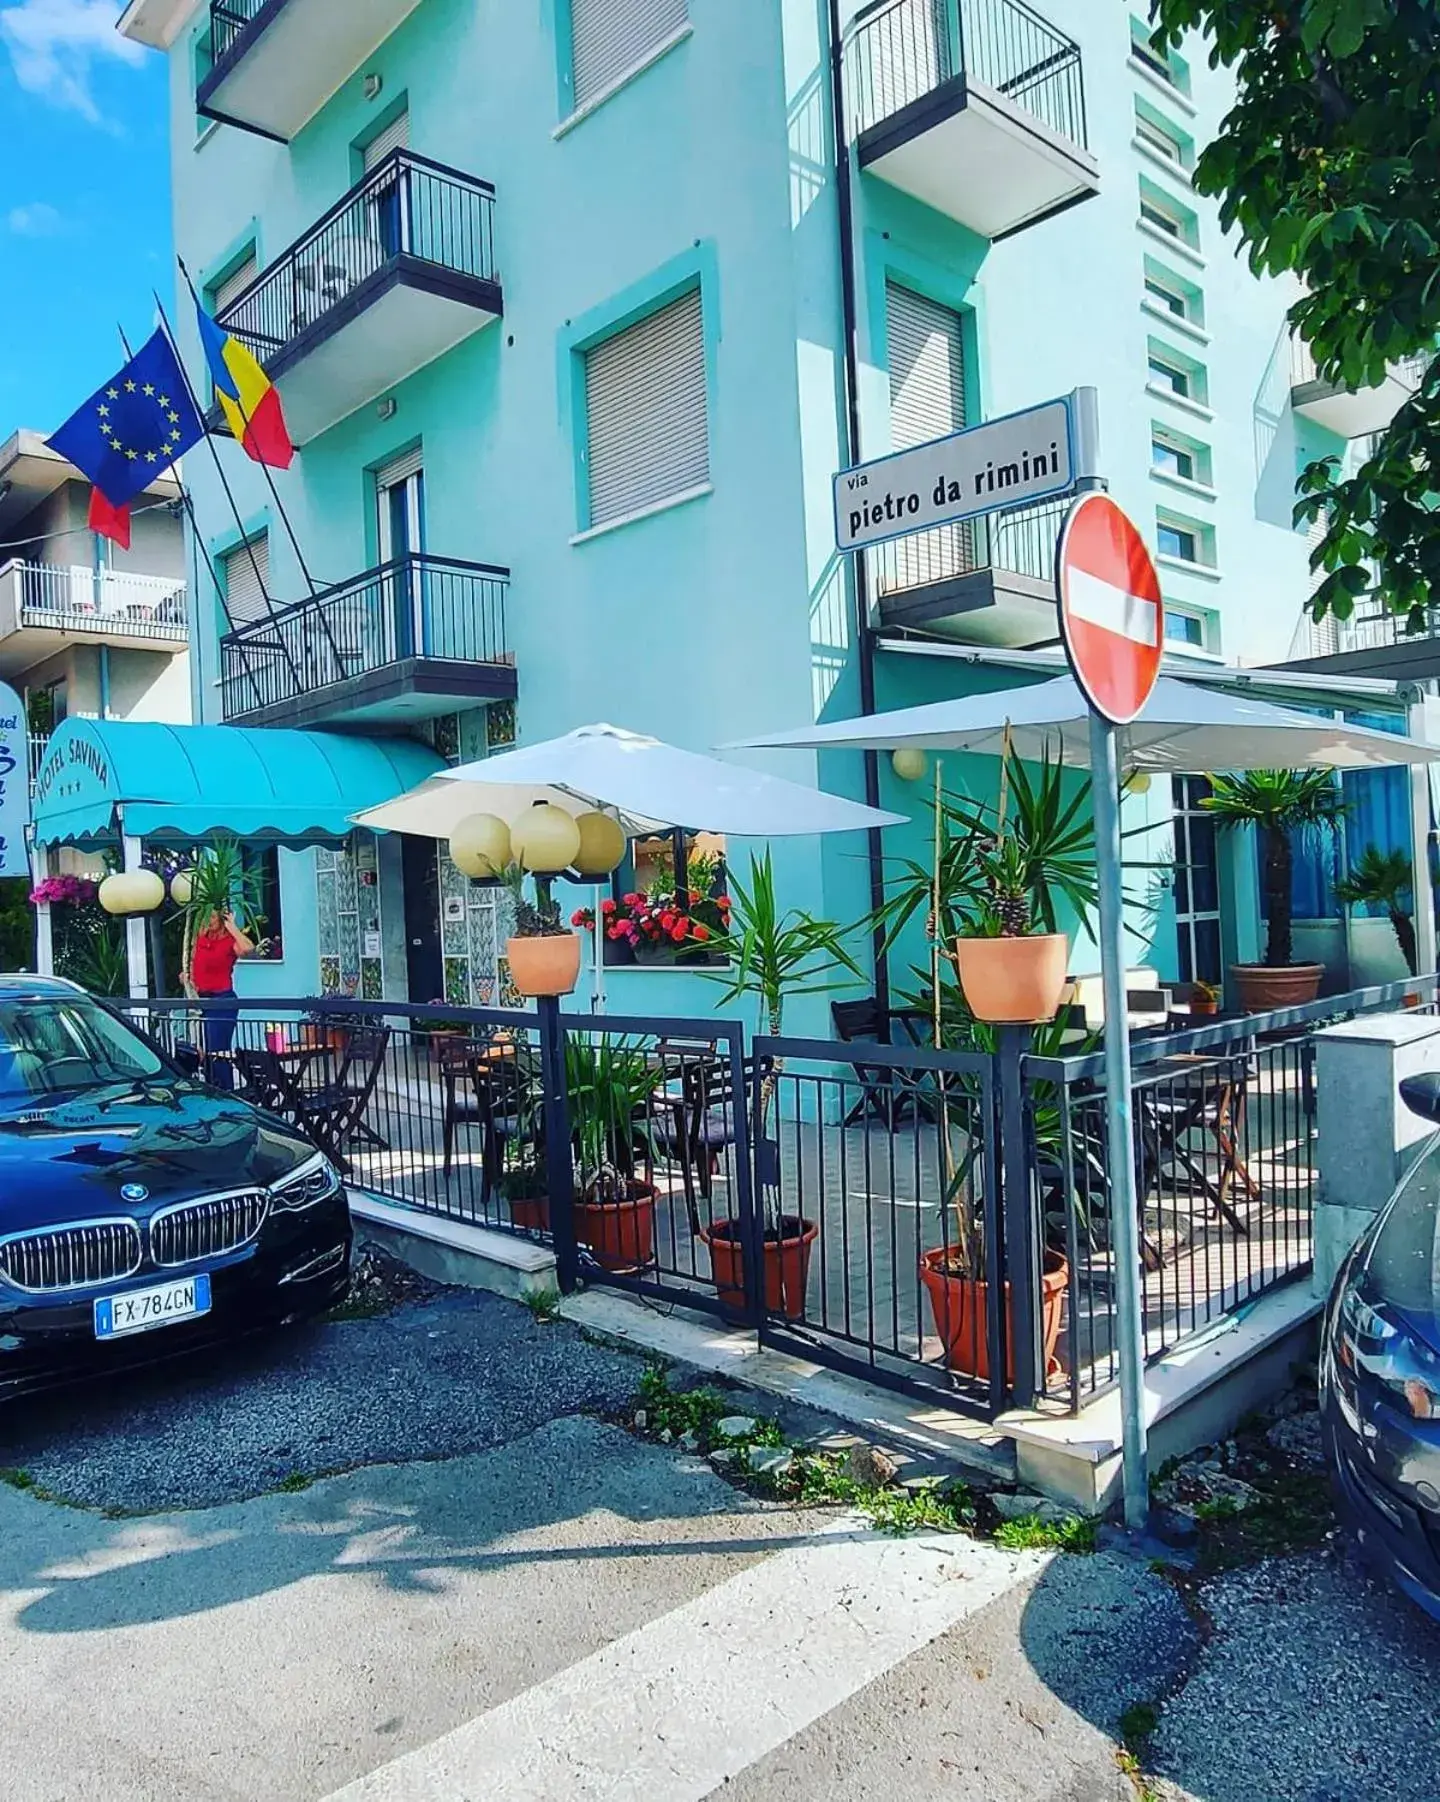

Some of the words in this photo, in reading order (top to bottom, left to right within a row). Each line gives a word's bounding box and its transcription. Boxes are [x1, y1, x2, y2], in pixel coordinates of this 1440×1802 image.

[847, 473, 868, 490] via
[849, 492, 920, 538] pietro
[933, 475, 962, 506] da
[974, 441, 1059, 495] rimini
[0, 714, 18, 730] tel
[38, 746, 65, 805] HOTEL
[69, 737, 108, 790] SAVINA
